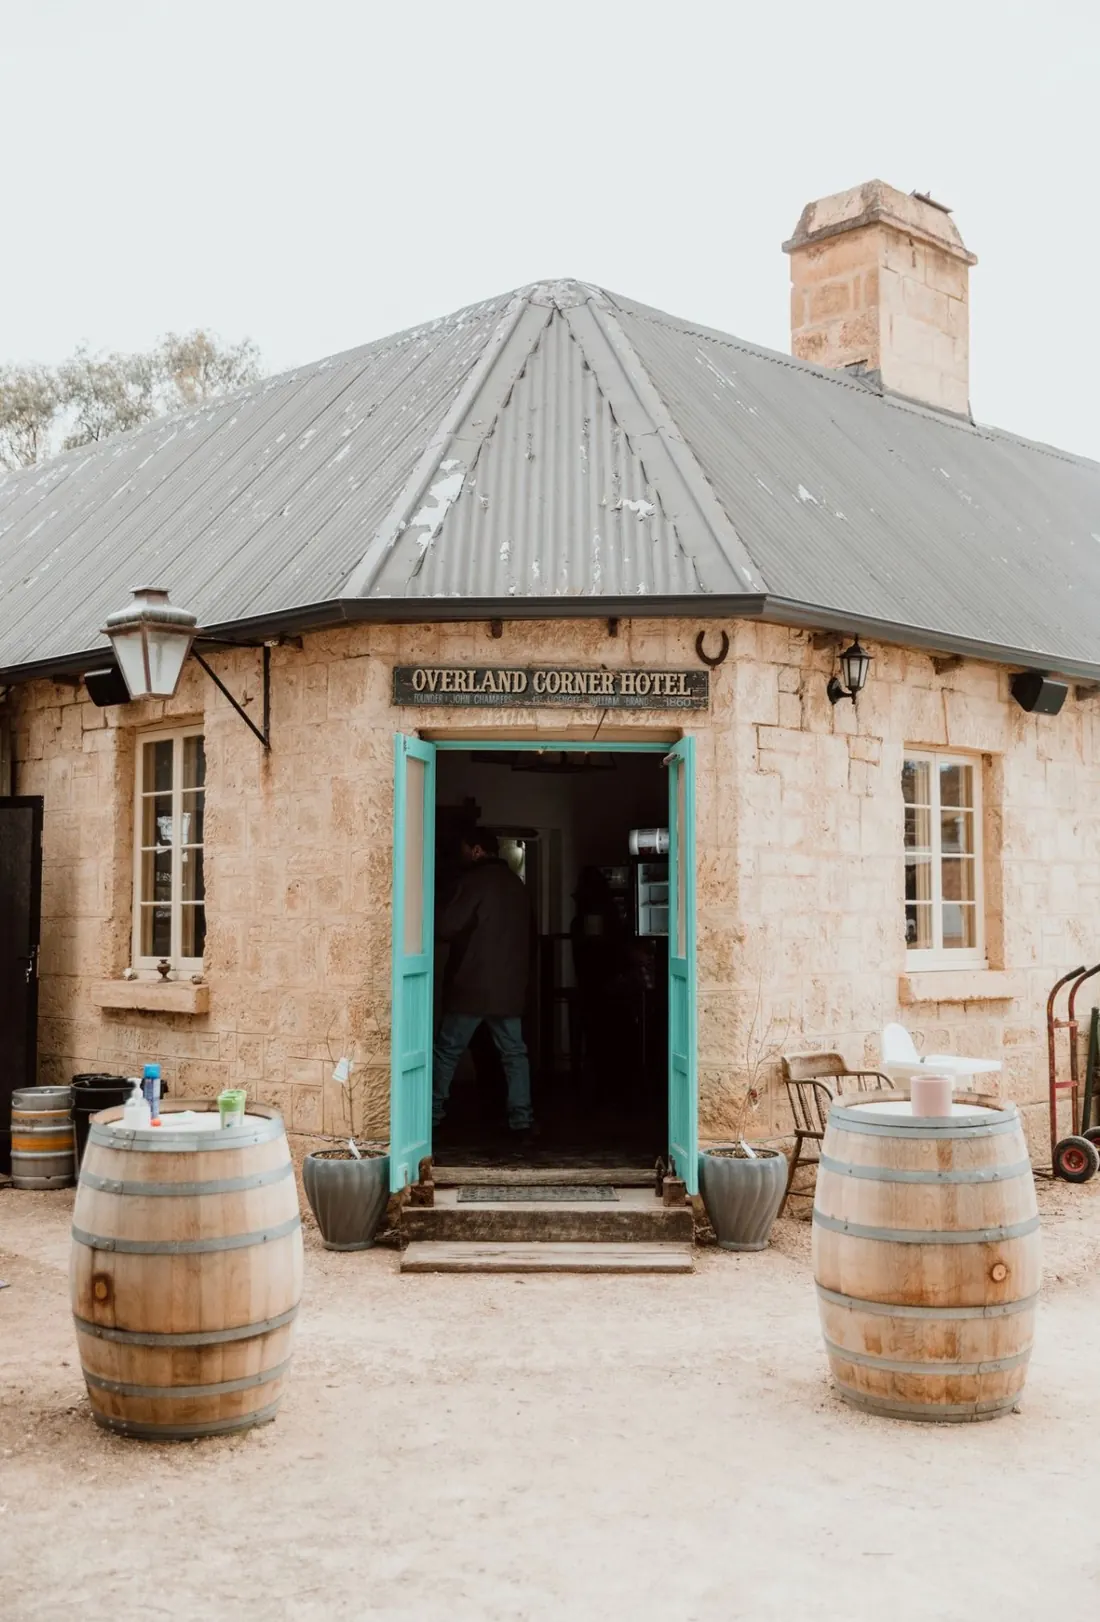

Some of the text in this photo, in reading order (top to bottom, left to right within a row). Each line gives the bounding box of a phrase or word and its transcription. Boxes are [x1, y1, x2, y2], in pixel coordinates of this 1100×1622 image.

[412, 669, 691, 695] OVERLAND CORNER HOTEL
[450, 693, 471, 704] JOHN
[664, 698, 691, 707] 1860
